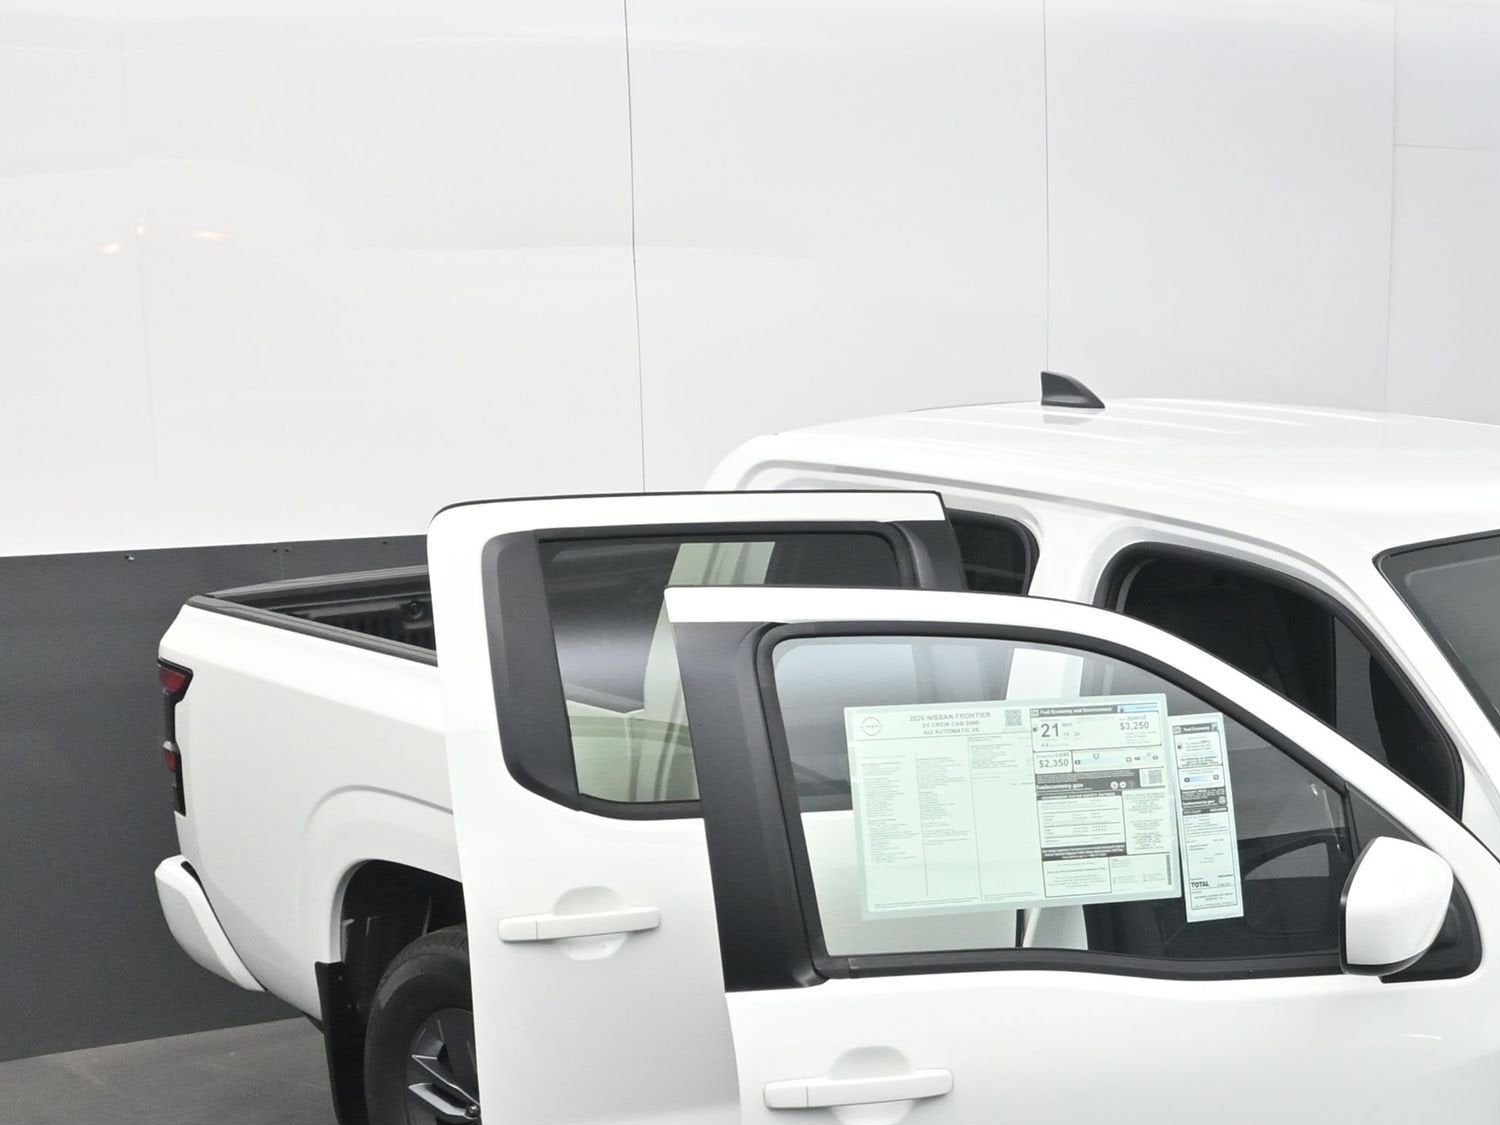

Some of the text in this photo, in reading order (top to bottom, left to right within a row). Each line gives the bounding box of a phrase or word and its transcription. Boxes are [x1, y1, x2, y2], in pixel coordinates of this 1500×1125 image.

[927, 713, 954, 721] NISSAN
[955, 711, 991, 719] FRONTIER
[1040, 723, 1059, 738] 21
[1120, 721, 1150, 731] $3,250
[1039, 758, 1069, 769] $2,350
